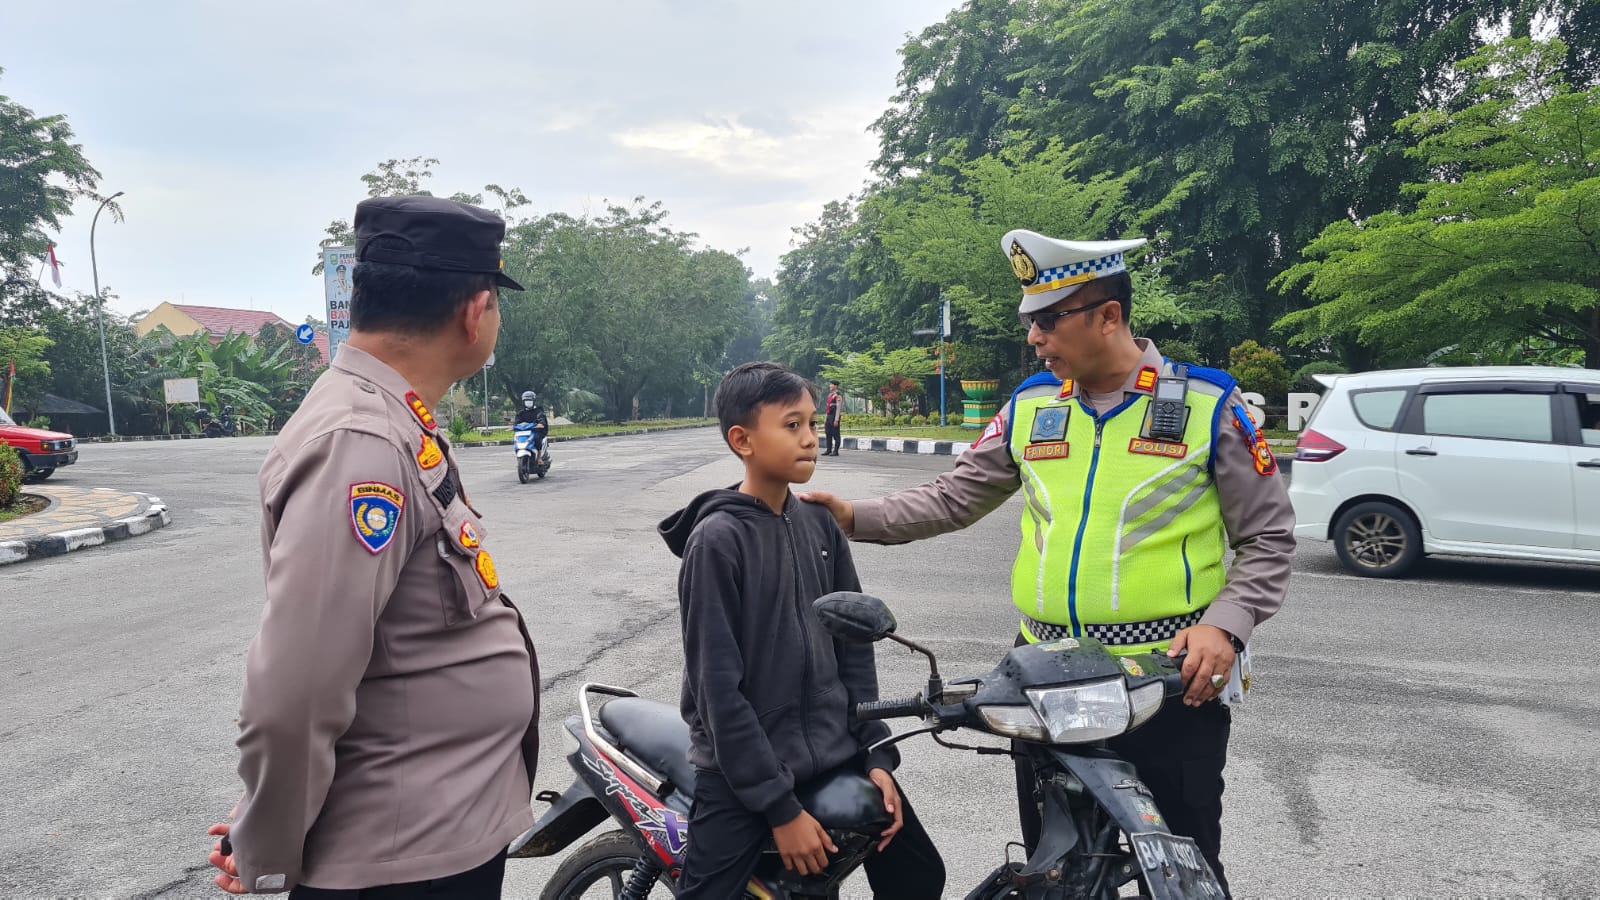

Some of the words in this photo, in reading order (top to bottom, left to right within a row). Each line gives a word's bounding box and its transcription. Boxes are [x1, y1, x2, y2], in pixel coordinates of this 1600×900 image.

[1027, 445, 1066, 458] FANDRI
[1133, 441, 1184, 454] POLISI
[357, 486, 400, 501] BINMAS
